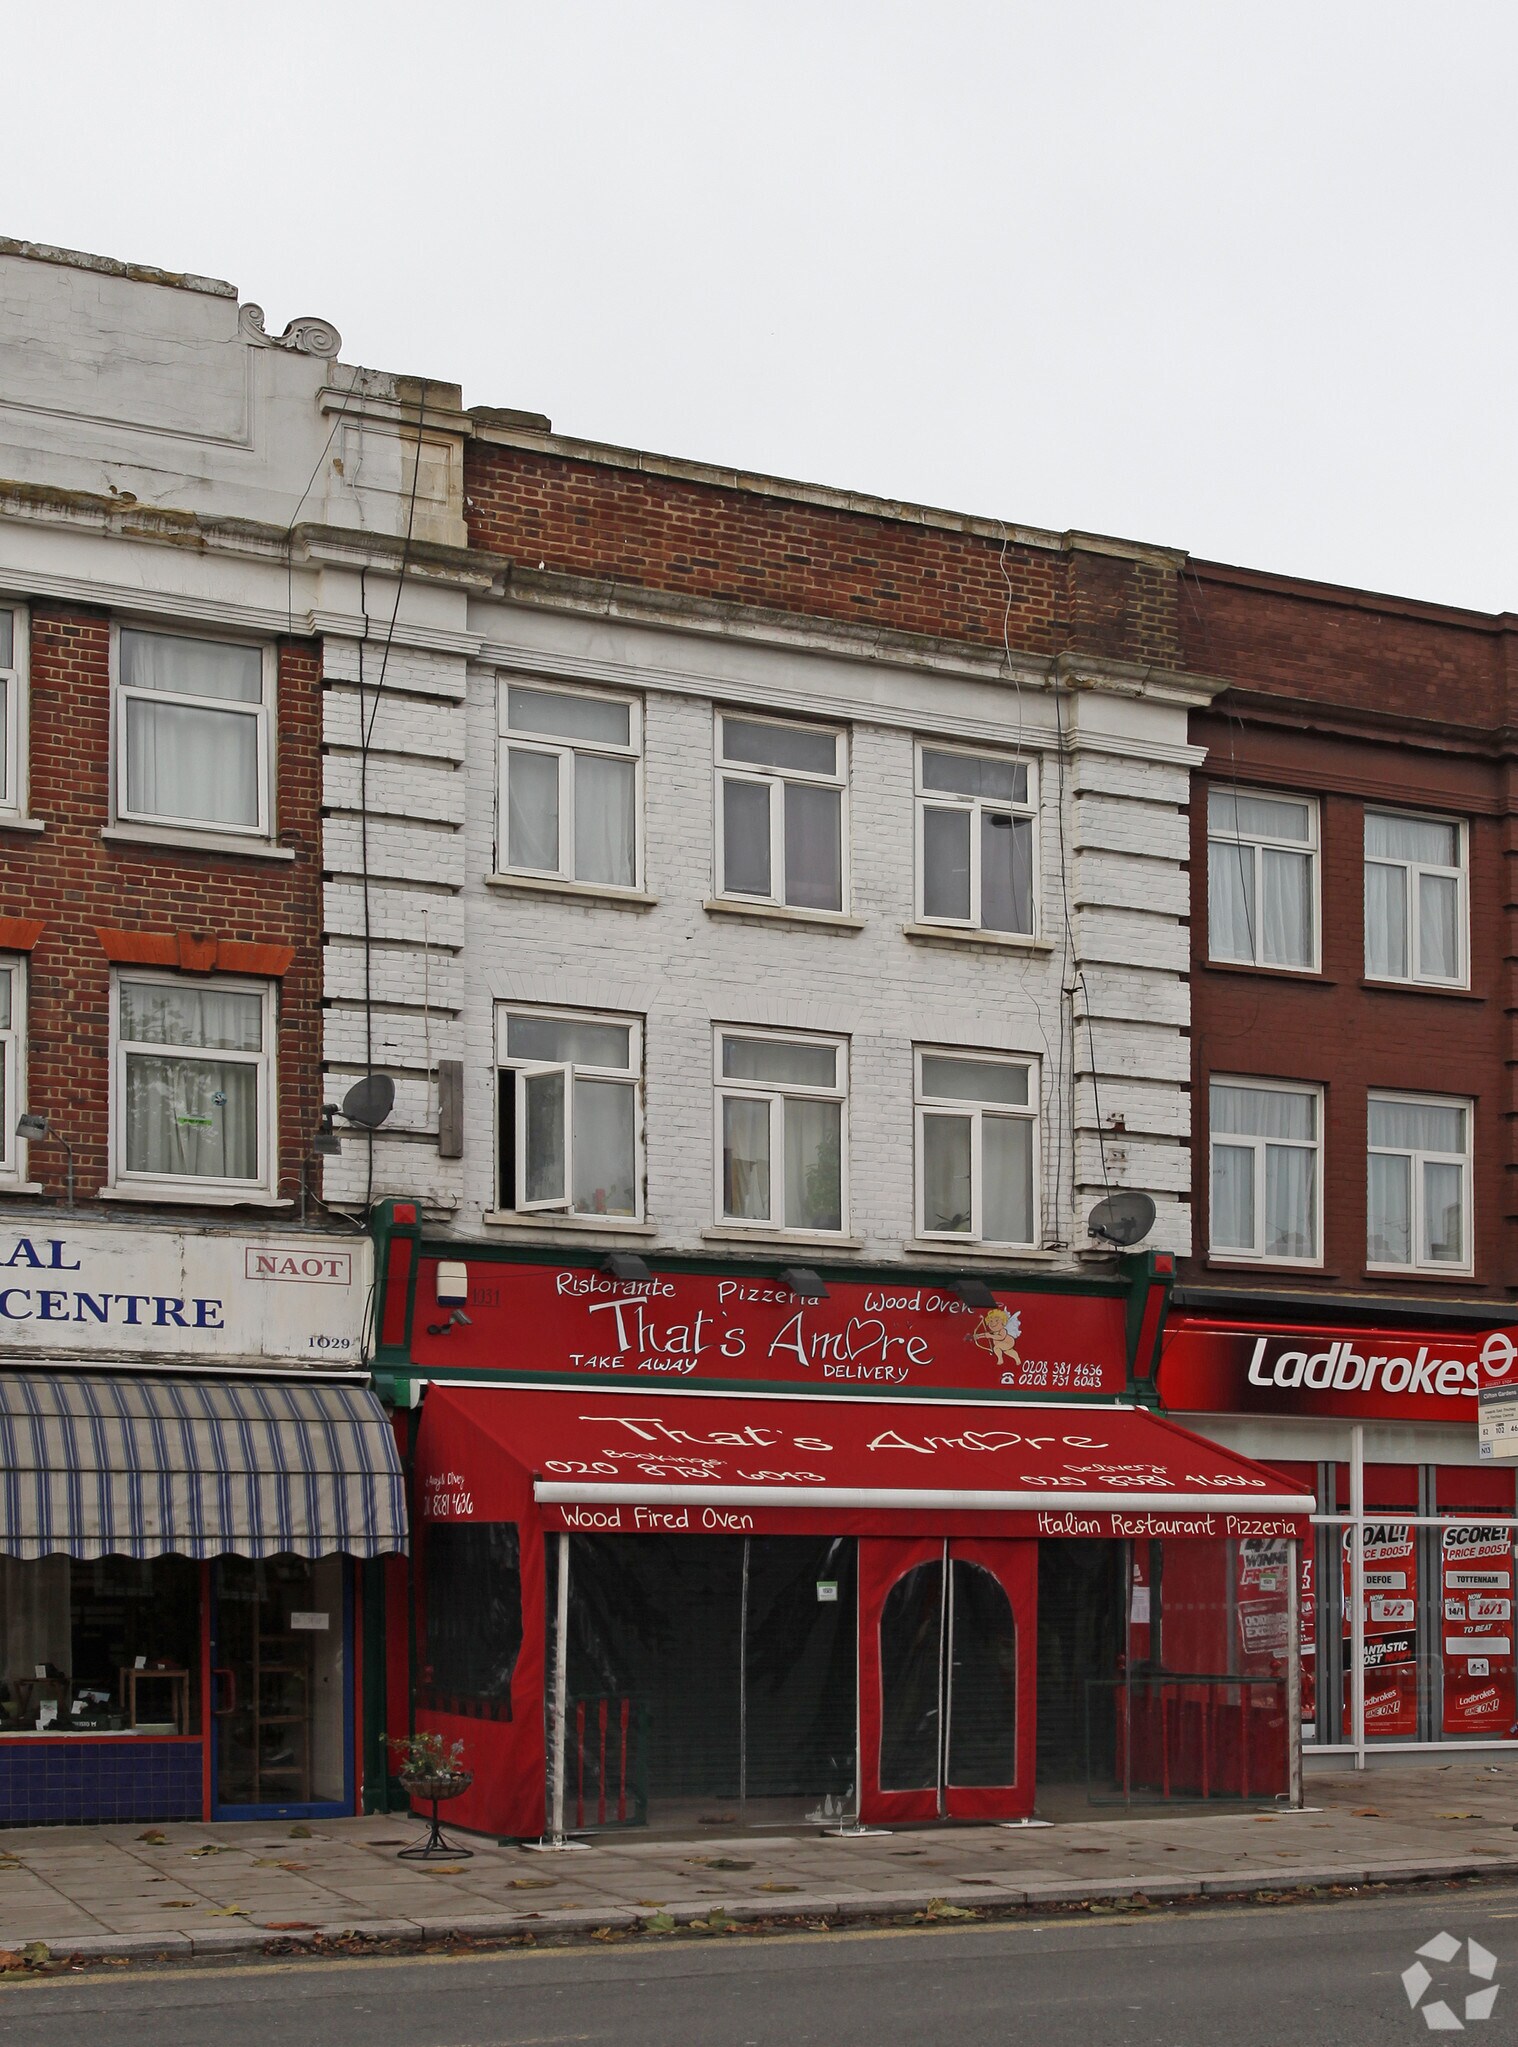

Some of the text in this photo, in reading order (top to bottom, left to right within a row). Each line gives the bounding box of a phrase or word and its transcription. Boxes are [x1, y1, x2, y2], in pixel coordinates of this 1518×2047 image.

[0, 1238, 81, 1270] AL
[255, 1256, 344, 1278] NAOT
[556, 1272, 677, 1298] Ristorante
[0, 1287, 225, 1329] CENTRE
[864, 1291, 975, 1314] Wood Oven
[589, 1296, 746, 1358] That's
[308, 1336, 351, 1350] 1029
[569, 1354, 698, 1375] TAKE AWAY
[1022, 1360, 1048, 1374] 0208
[1052, 1362, 1071, 1375] 381
[1248, 1338, 1479, 1397] Ladbrokes
[1018, 1373, 1047, 1386] 0208
[1073, 1376, 1102, 1388] 6043
[578, 1415, 834, 1452] That's
[545, 1460, 826, 1483] 020 8731 6043
[1020, 1474, 1267, 1488] 020 8381 4636
[560, 1505, 754, 1530] Wood Fired Oven
[1038, 1511, 1297, 1536] Italian Restaurant Pizzeria
[1445, 1527, 1508, 1547] SCORE!
[1380, 1545, 1411, 1558] BOOST
[1449, 1543, 1508, 1560] PRICE BOOST
[1366, 1575, 1392, 1584] DEFOE
[1457, 1575, 1499, 1584] TOTTENHAM
[1383, 1604, 1405, 1617] 5/2
[1464, 1626, 1474, 1634] TO
[1363, 1641, 1408, 1656] ANTASTIC
[1363, 1654, 1383, 1666] OST
[1364, 1689, 1397, 1707] adbrokes
[1459, 1687, 1496, 1706] Ladbrokes
[1381, 1701, 1401, 1716] ON!
[1481, 1699, 1500, 1713] ON!
